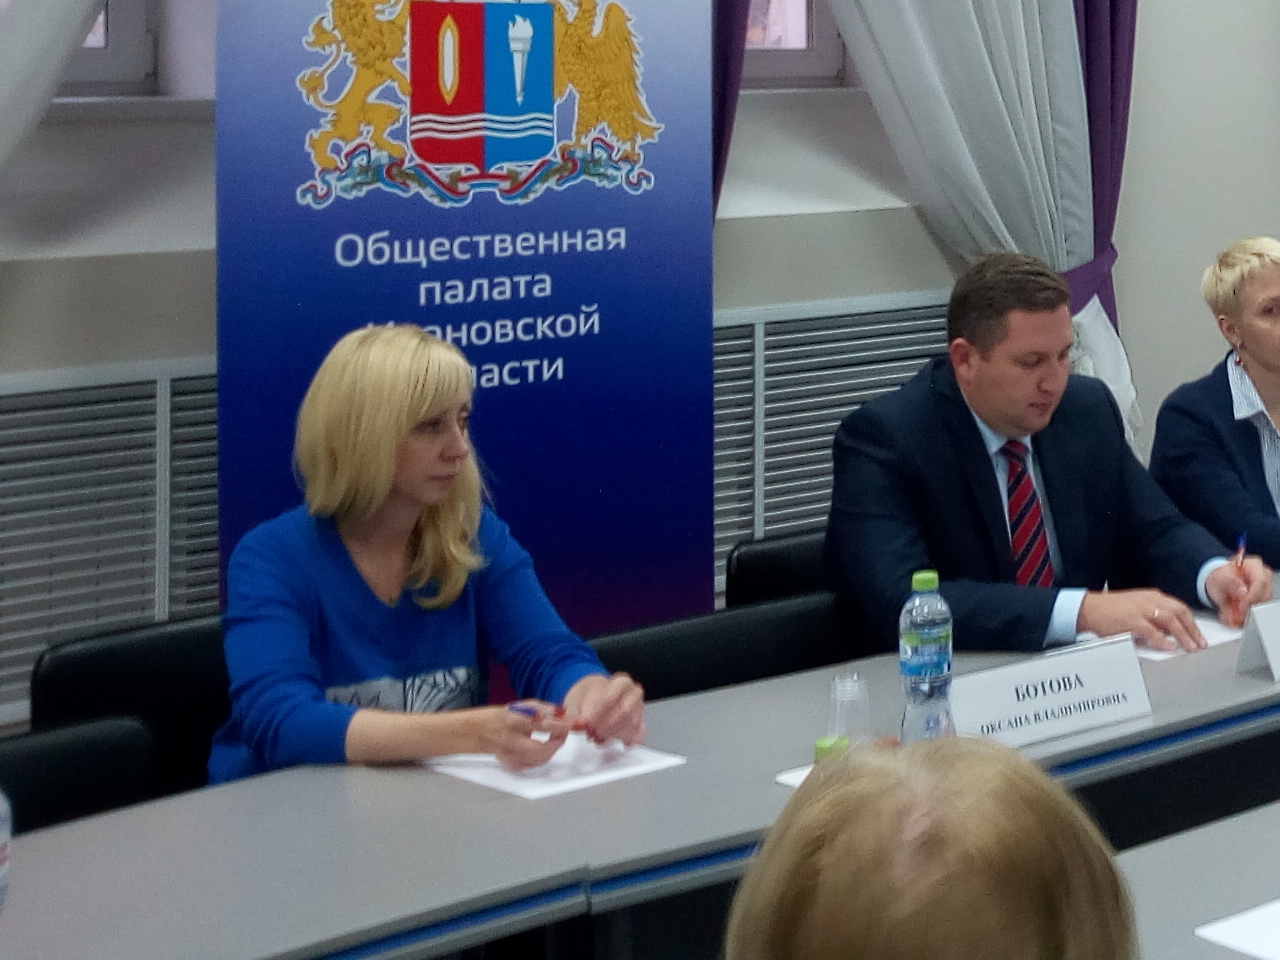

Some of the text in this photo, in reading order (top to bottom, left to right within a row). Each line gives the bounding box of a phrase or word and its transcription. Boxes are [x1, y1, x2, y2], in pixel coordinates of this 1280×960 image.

[334, 225, 627, 268] Общественная
[418, 272, 552, 307] палата
[1014, 673, 1085, 703] БОТОВА
[980, 691, 1129, 737] ОКСАНА ВЛАДИМИРОВНА
